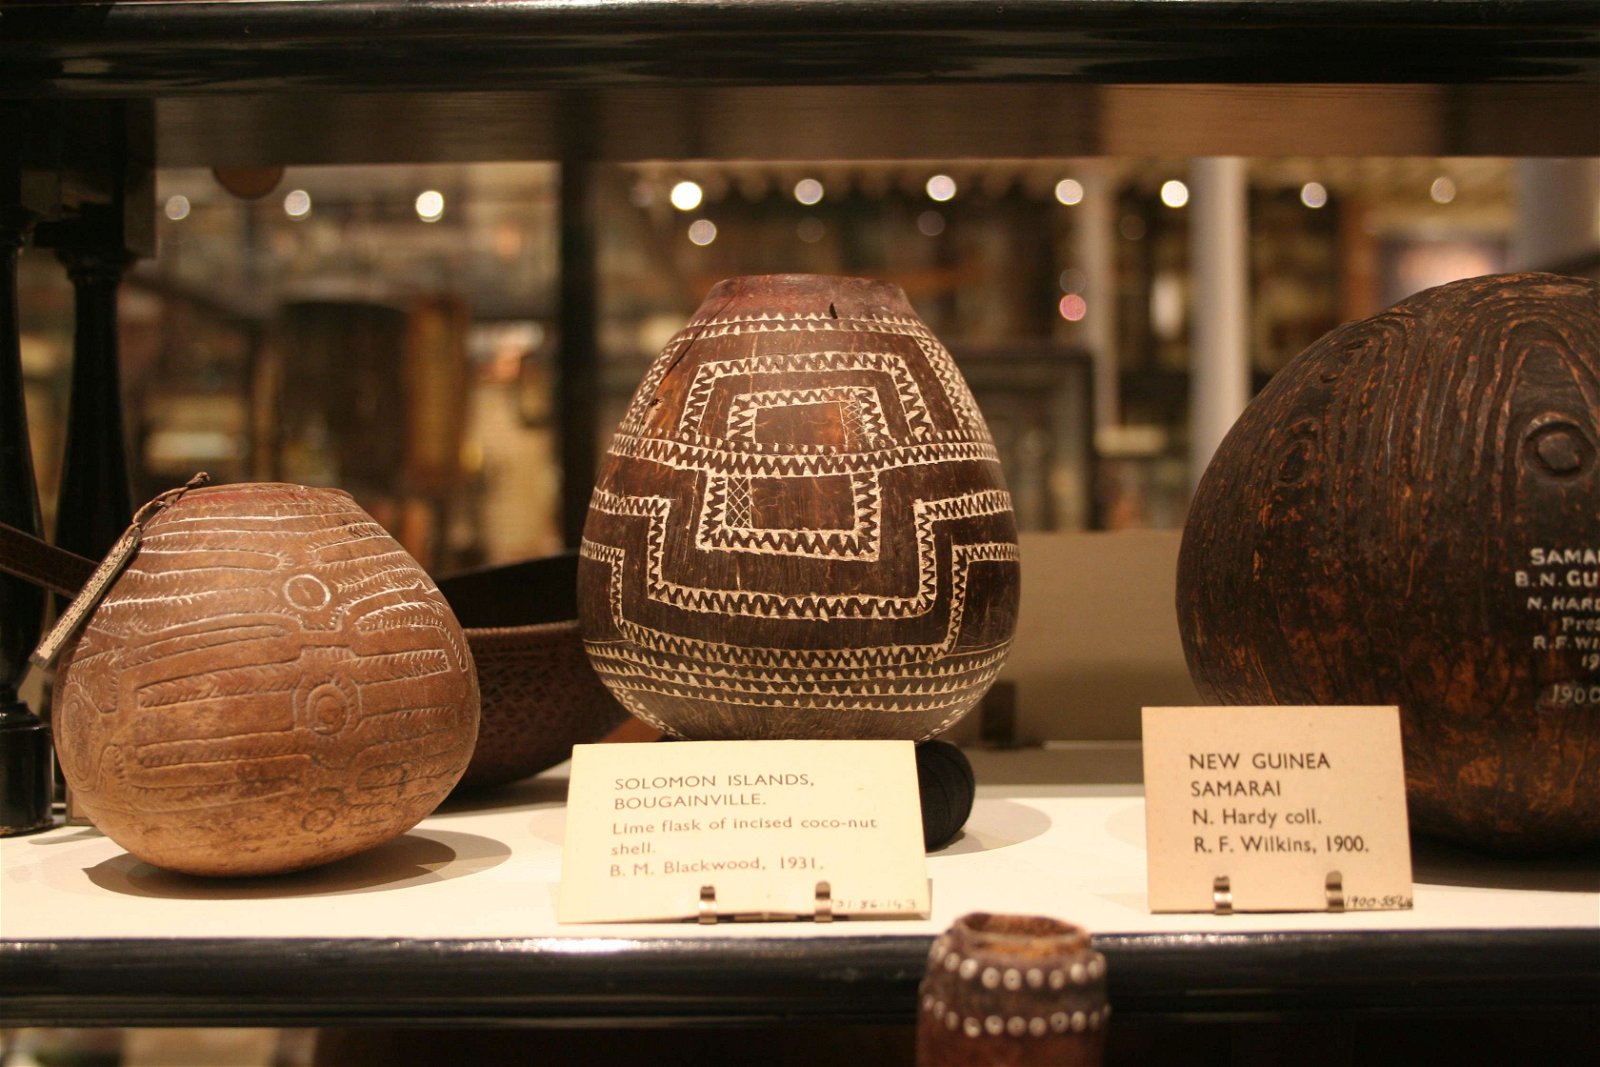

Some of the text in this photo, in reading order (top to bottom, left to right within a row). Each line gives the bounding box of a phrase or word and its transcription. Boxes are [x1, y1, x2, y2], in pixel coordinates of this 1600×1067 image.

[1530, 547, 1600, 566] SAMA
[1189, 753, 1331, 769] NEW GUINEA
[614, 773, 815, 791] SOLOMON ISLANDS,
[1191, 780, 1281, 797] SAMARAI
[614, 793, 767, 810] BOUGAINVILLE.
[612, 816, 878, 836] Lime flask of incised coco-nut
[1192, 808, 1323, 829] N. Hardy coll.
[611, 843, 656, 856] shell.
[1193, 834, 1370, 855] R. F. Wilkins, 1900.
[609, 857, 825, 878] B. M. Blackwood, 1931.
